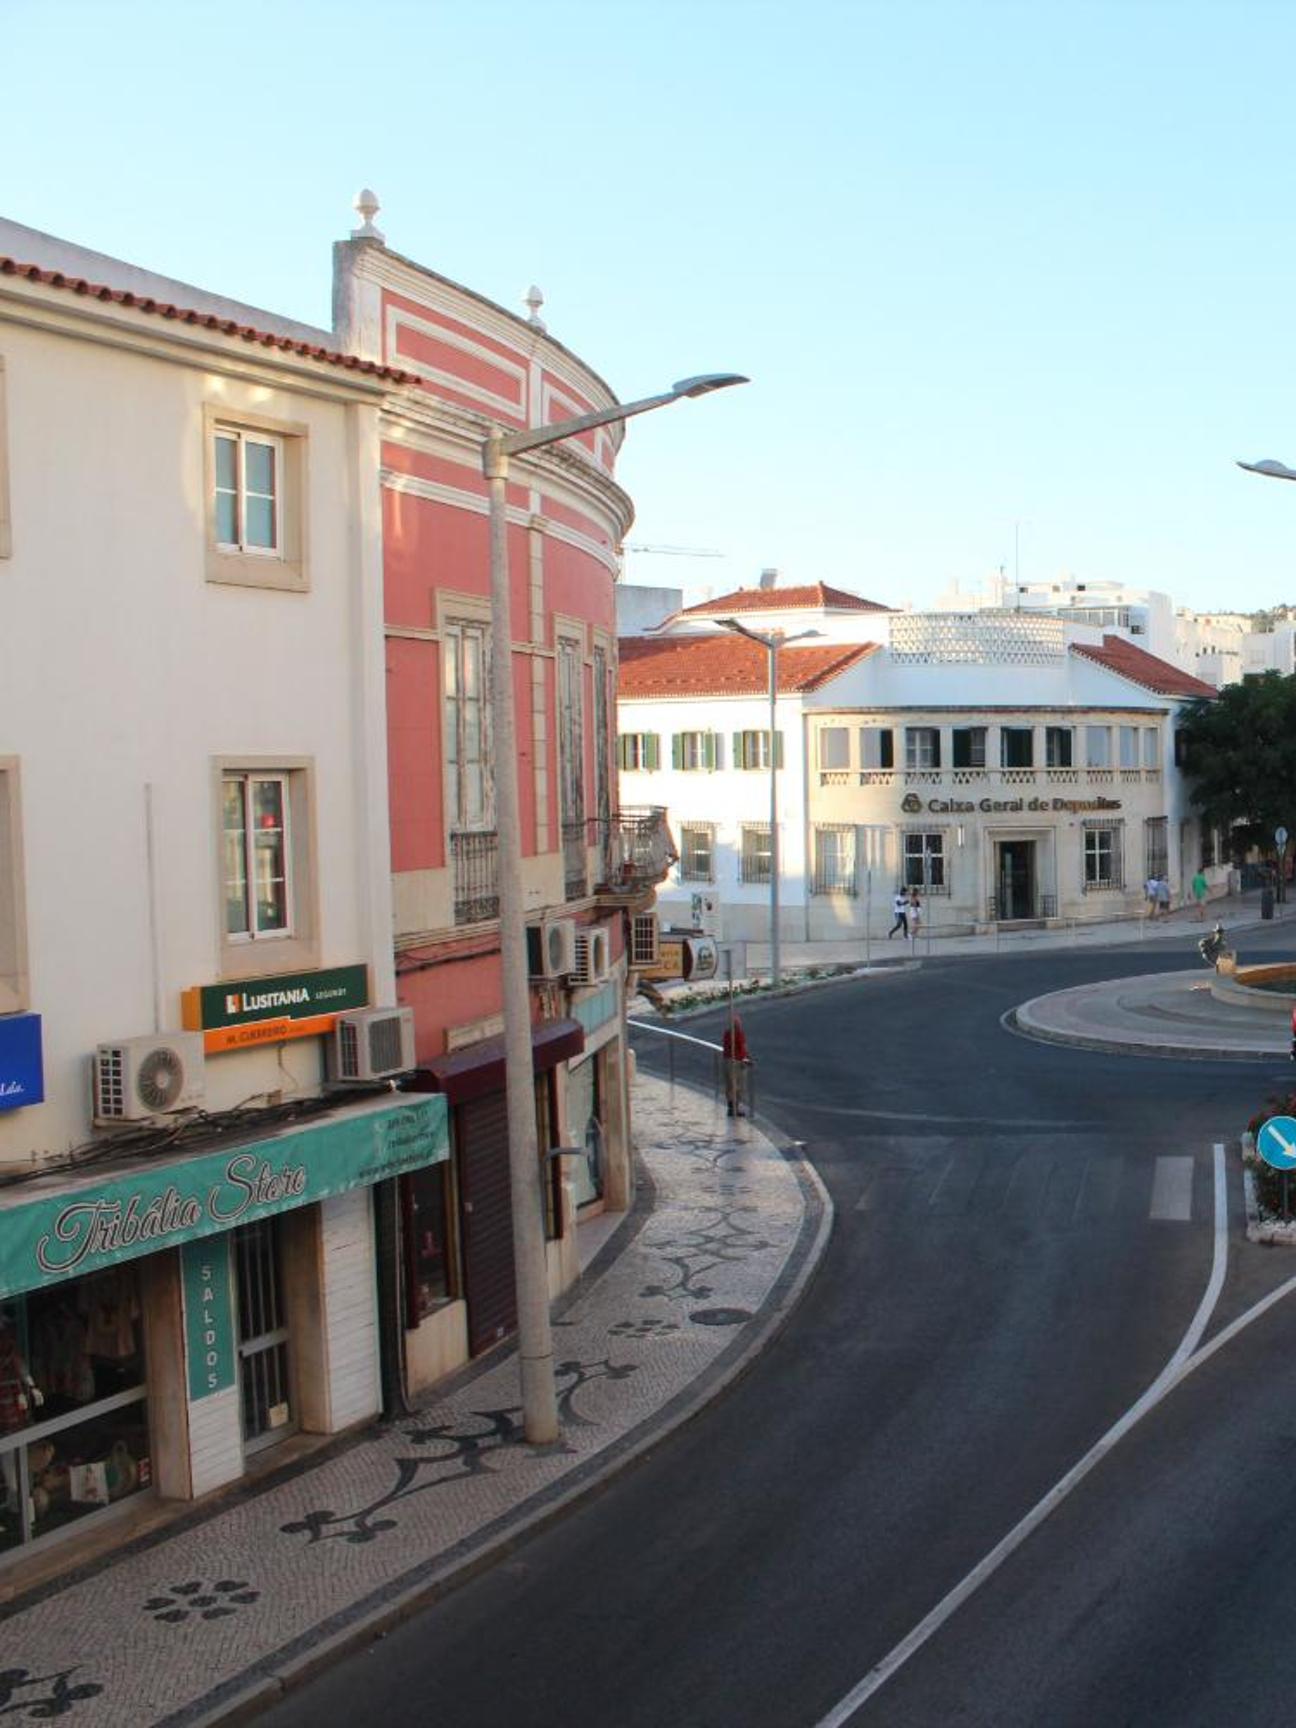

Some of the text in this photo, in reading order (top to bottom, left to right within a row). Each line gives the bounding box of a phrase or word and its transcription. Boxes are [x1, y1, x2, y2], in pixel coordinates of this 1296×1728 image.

[928, 798, 975, 813] Caixa
[979, 798, 1023, 813] Geral
[1027, 798, 1049, 812] de
[242, 987, 310, 1012] LUSITANIA
[36, 1153, 306, 1273] Tribália Store
[201, 1264, 219, 1389] SALDOS
